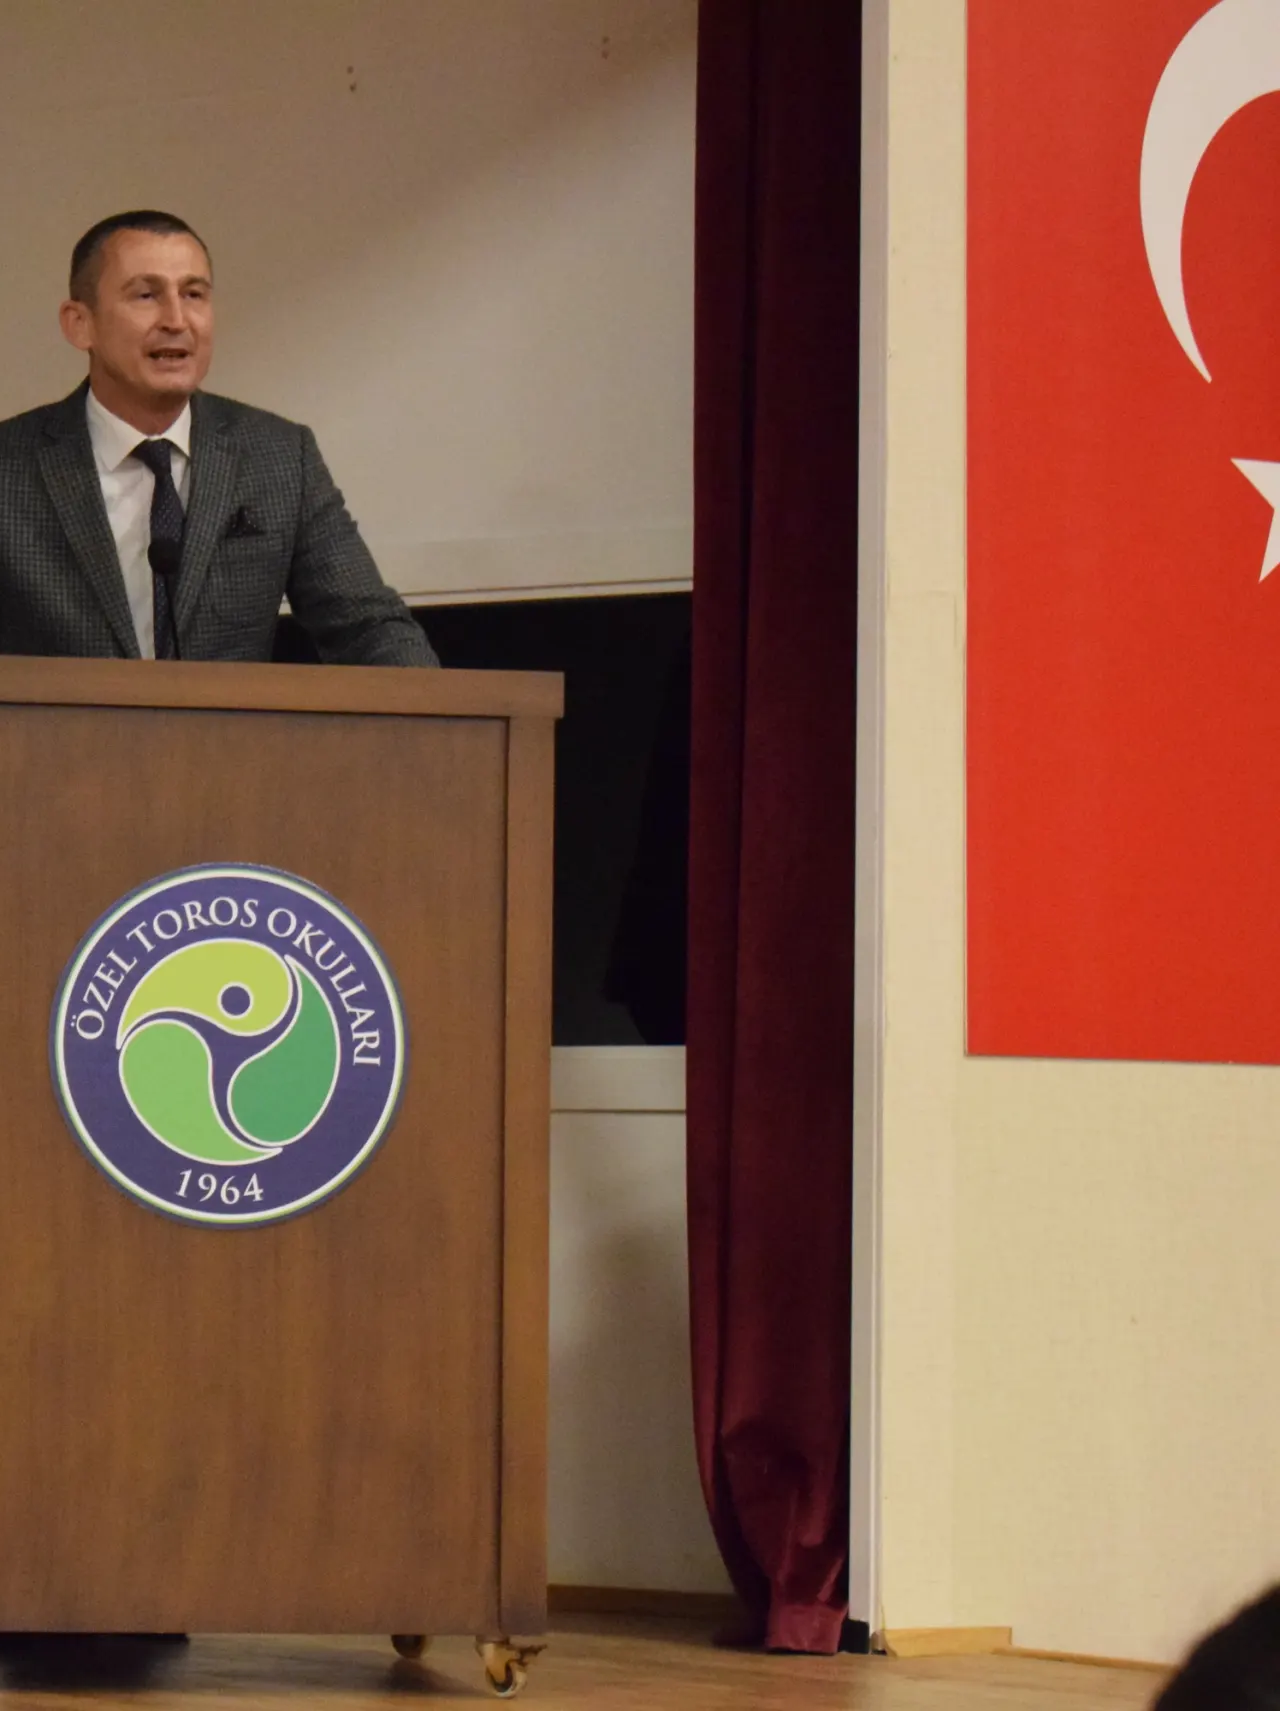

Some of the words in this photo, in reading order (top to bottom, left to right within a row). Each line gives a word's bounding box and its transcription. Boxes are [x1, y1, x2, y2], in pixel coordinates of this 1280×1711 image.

[70, 949, 138, 1041] ÖZEL
[125, 896, 259, 953] TOROS
[267, 907, 381, 1066] OKULLARI
[175, 1168, 264, 1205] 1964
